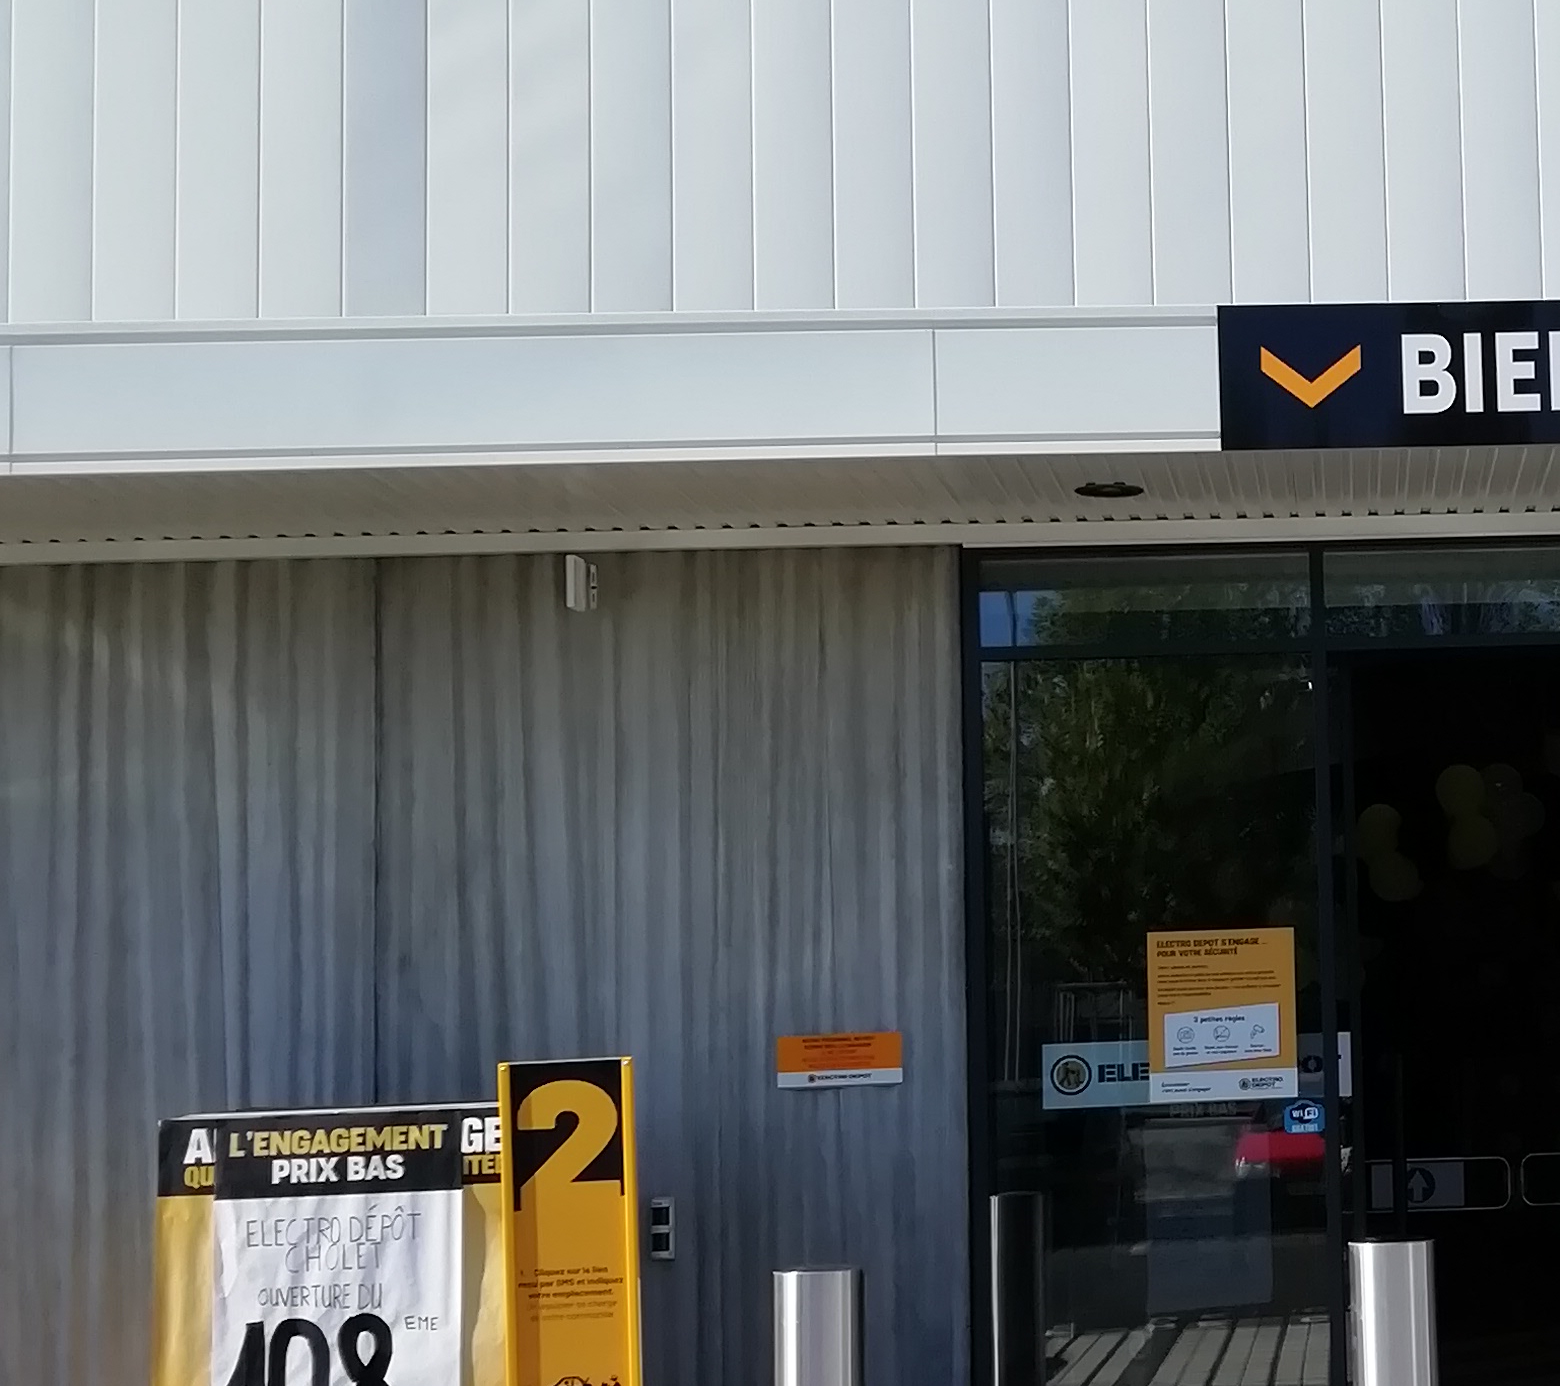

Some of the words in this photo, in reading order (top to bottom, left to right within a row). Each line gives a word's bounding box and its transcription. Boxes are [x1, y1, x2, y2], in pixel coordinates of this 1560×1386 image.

[183, 1127, 217, 1164] A
[228, 1123, 449, 1159] L'ENGAGEMENT
[516, 1079, 622, 1207] 2
[271, 1158, 339, 1185] PRIX
[346, 1154, 405, 1182] BAS
[245, 1215, 342, 1248] ELECTRO
[348, 1204, 422, 1244] DÉPÔT
[285, 1240, 383, 1274] CHOLET
[257, 1283, 351, 1310] OUVERTURE
[357, 1283, 383, 1311] DU
[404, 1316, 439, 1332] EME
